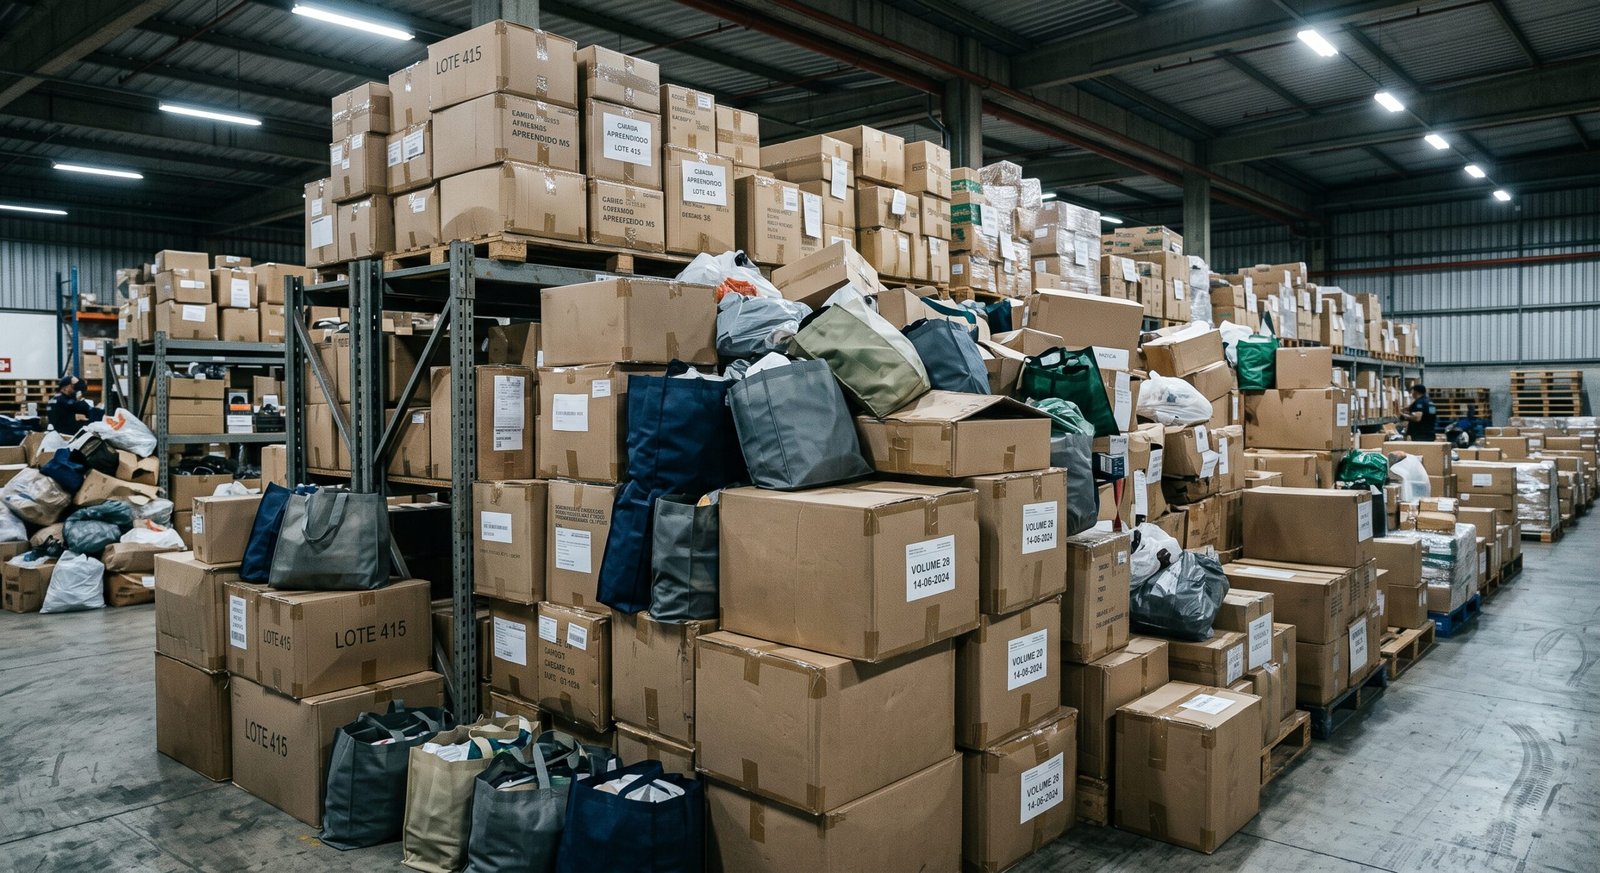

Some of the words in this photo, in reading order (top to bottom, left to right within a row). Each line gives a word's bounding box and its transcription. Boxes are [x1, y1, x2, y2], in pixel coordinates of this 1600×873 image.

[436, 53, 460, 75] LOTE
[462, 46, 482, 64] 415
[512, 129, 557, 145] APREENDIDO
[614, 145, 629, 153] LOTE
[1026, 520, 1046, 531] VOLUME
[911, 559, 941, 574] VOLUME
[914, 572, 949, 589] 14-06-2024
[263, 629, 279, 647] LOTE
[279, 635, 291, 651] 415
[336, 625, 376, 649] LOTE
[380, 620, 406, 639] 415
[1012, 651, 1035, 666] VOLUME
[245, 718, 268, 749] LOTE
[270, 732, 288, 757] 415
[1027, 777, 1052, 797] VOLUME
